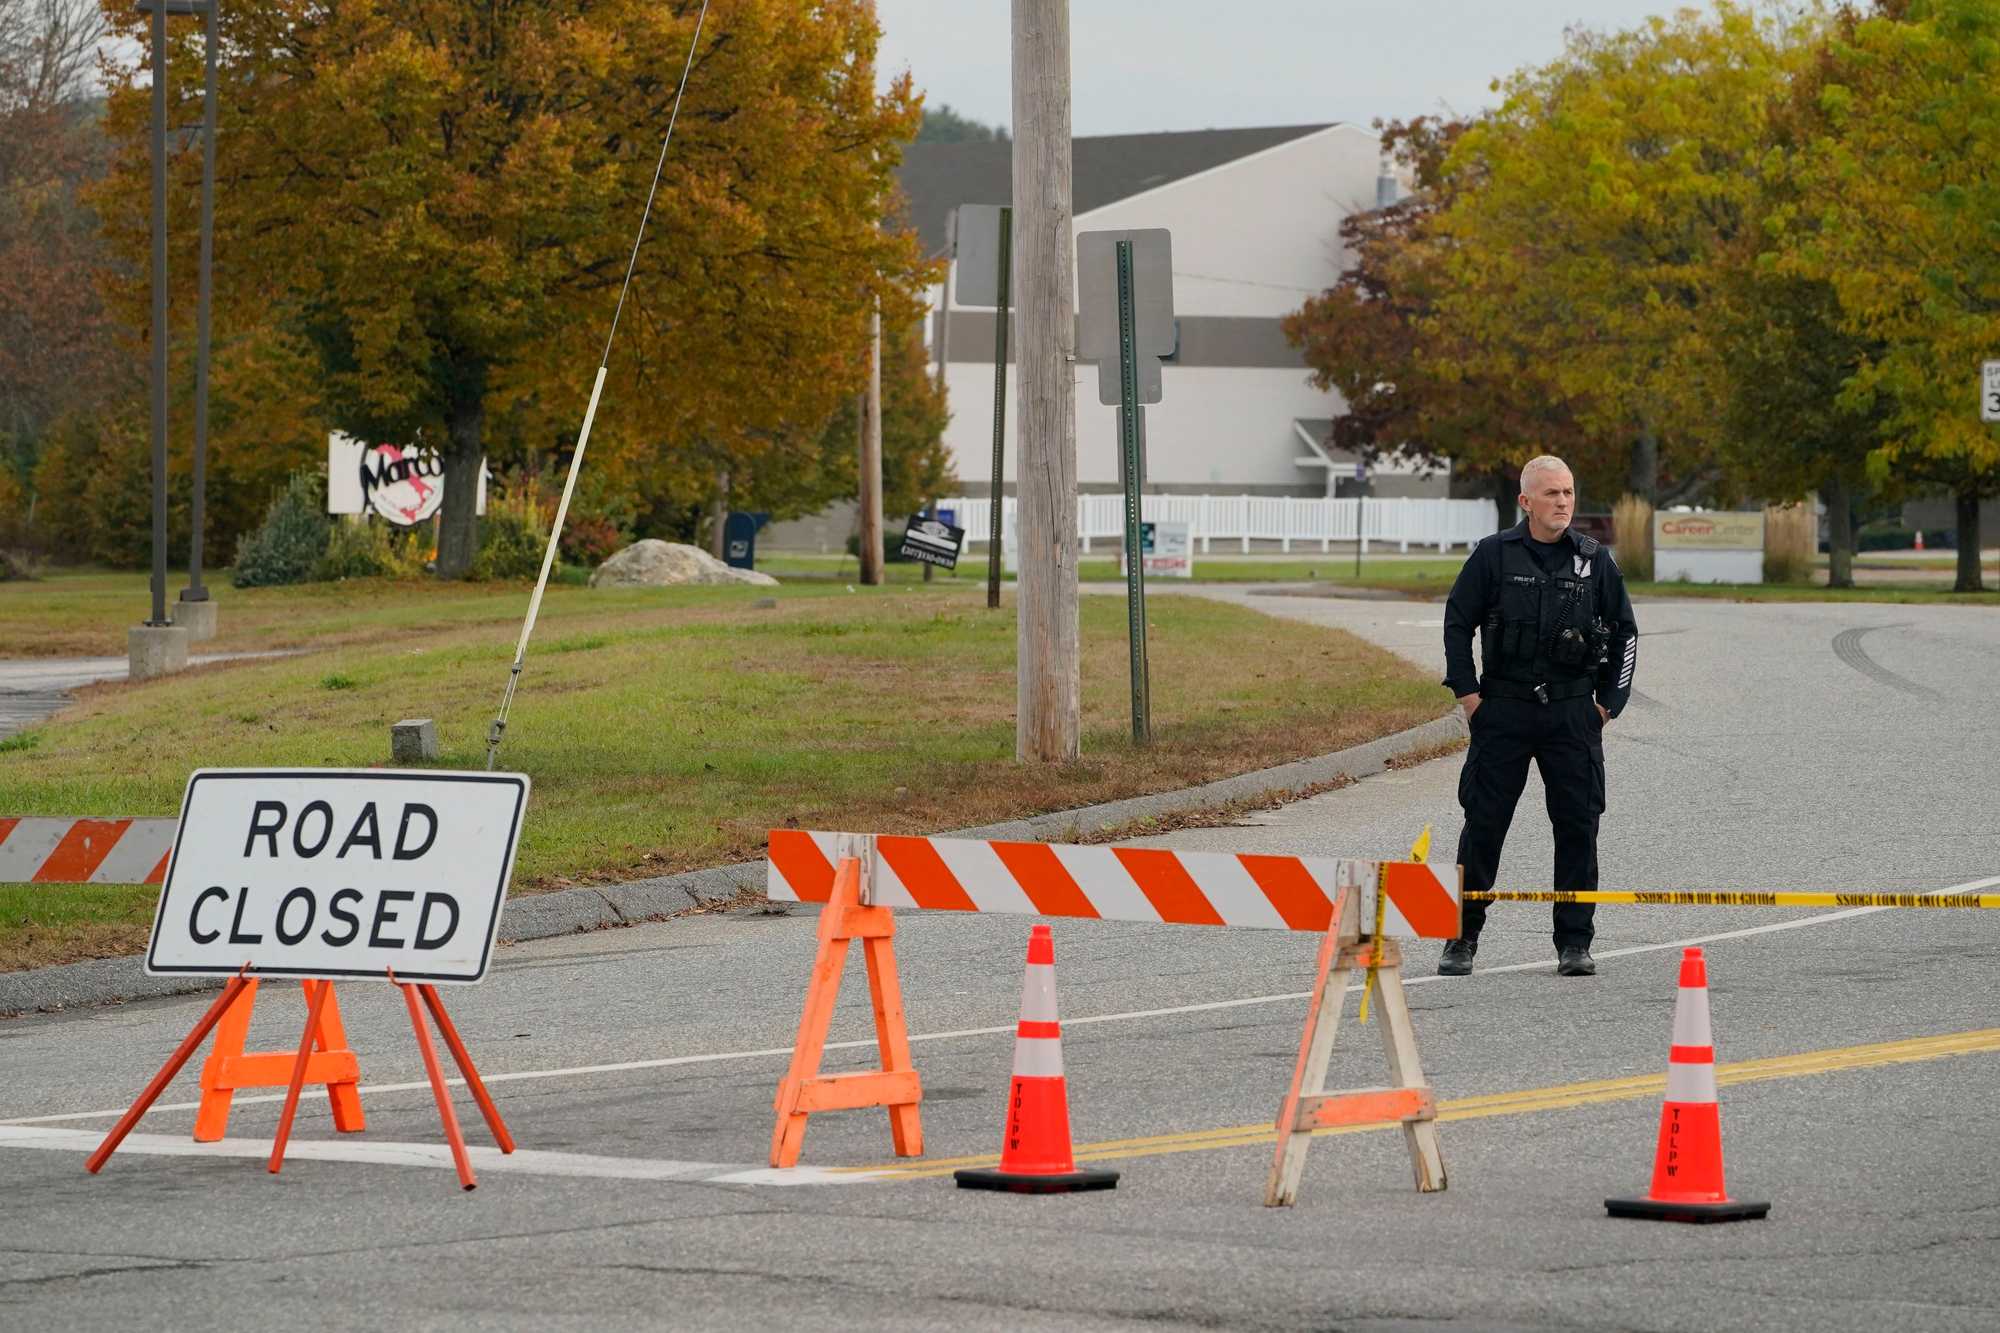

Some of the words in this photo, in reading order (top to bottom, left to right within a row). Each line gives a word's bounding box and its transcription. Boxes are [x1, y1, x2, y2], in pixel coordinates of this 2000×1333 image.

[243, 800, 439, 861] ROAD
[1634, 893, 1671, 904] CROSS
[1674, 893, 1694, 904] NOT
[1714, 893, 1737, 904] LINE
[1740, 893, 1775, 904] POLICE
[1836, 893, 1873, 906] CROSS
[1877, 894, 1896, 906] NOT
[1917, 894, 1940, 907] LINE
[1944, 895, 1981, 907] POLICE
[189, 886, 460, 950] CLOSED
